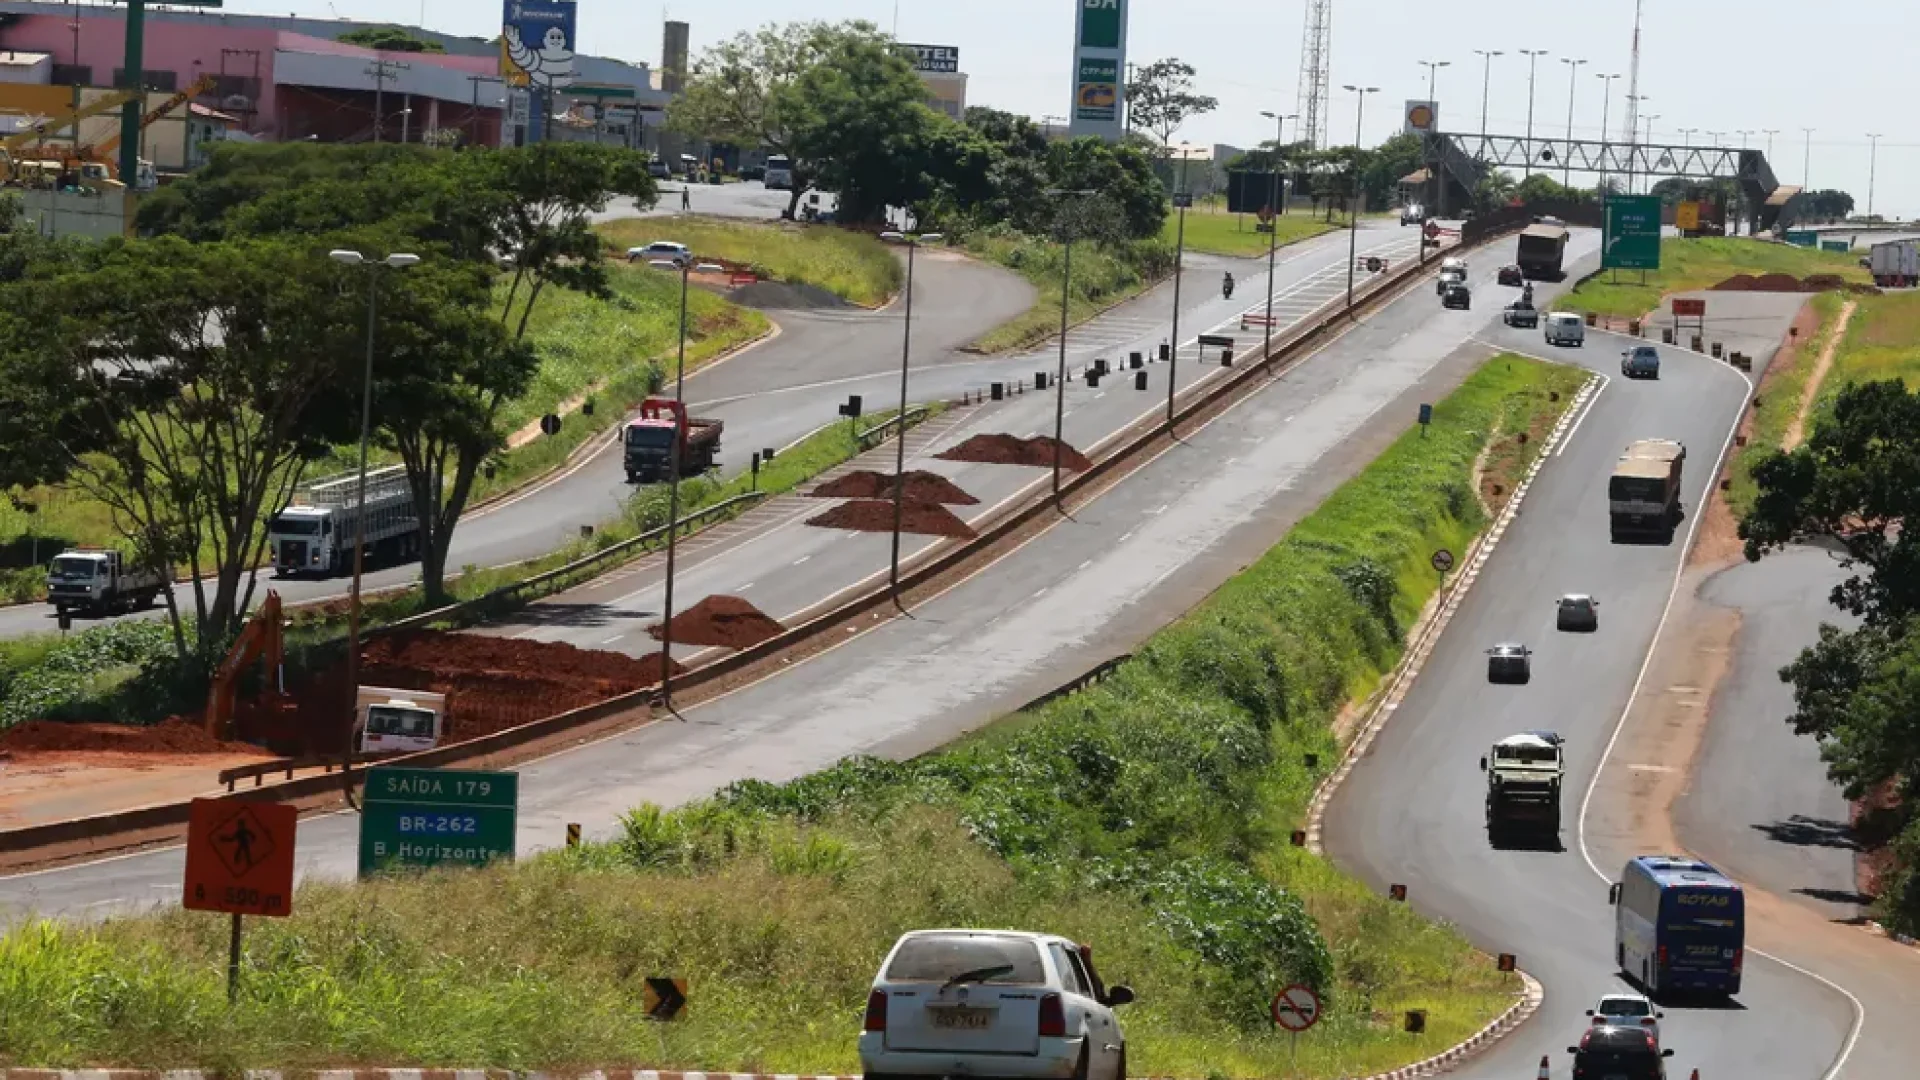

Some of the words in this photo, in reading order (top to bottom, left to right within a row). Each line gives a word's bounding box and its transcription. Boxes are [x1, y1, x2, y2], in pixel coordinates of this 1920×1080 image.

[387, 776, 443, 794] SAÍDA
[456, 781, 492, 796] 179
[400, 816, 476, 833] BR-262
[225, 886, 259, 906] 500
